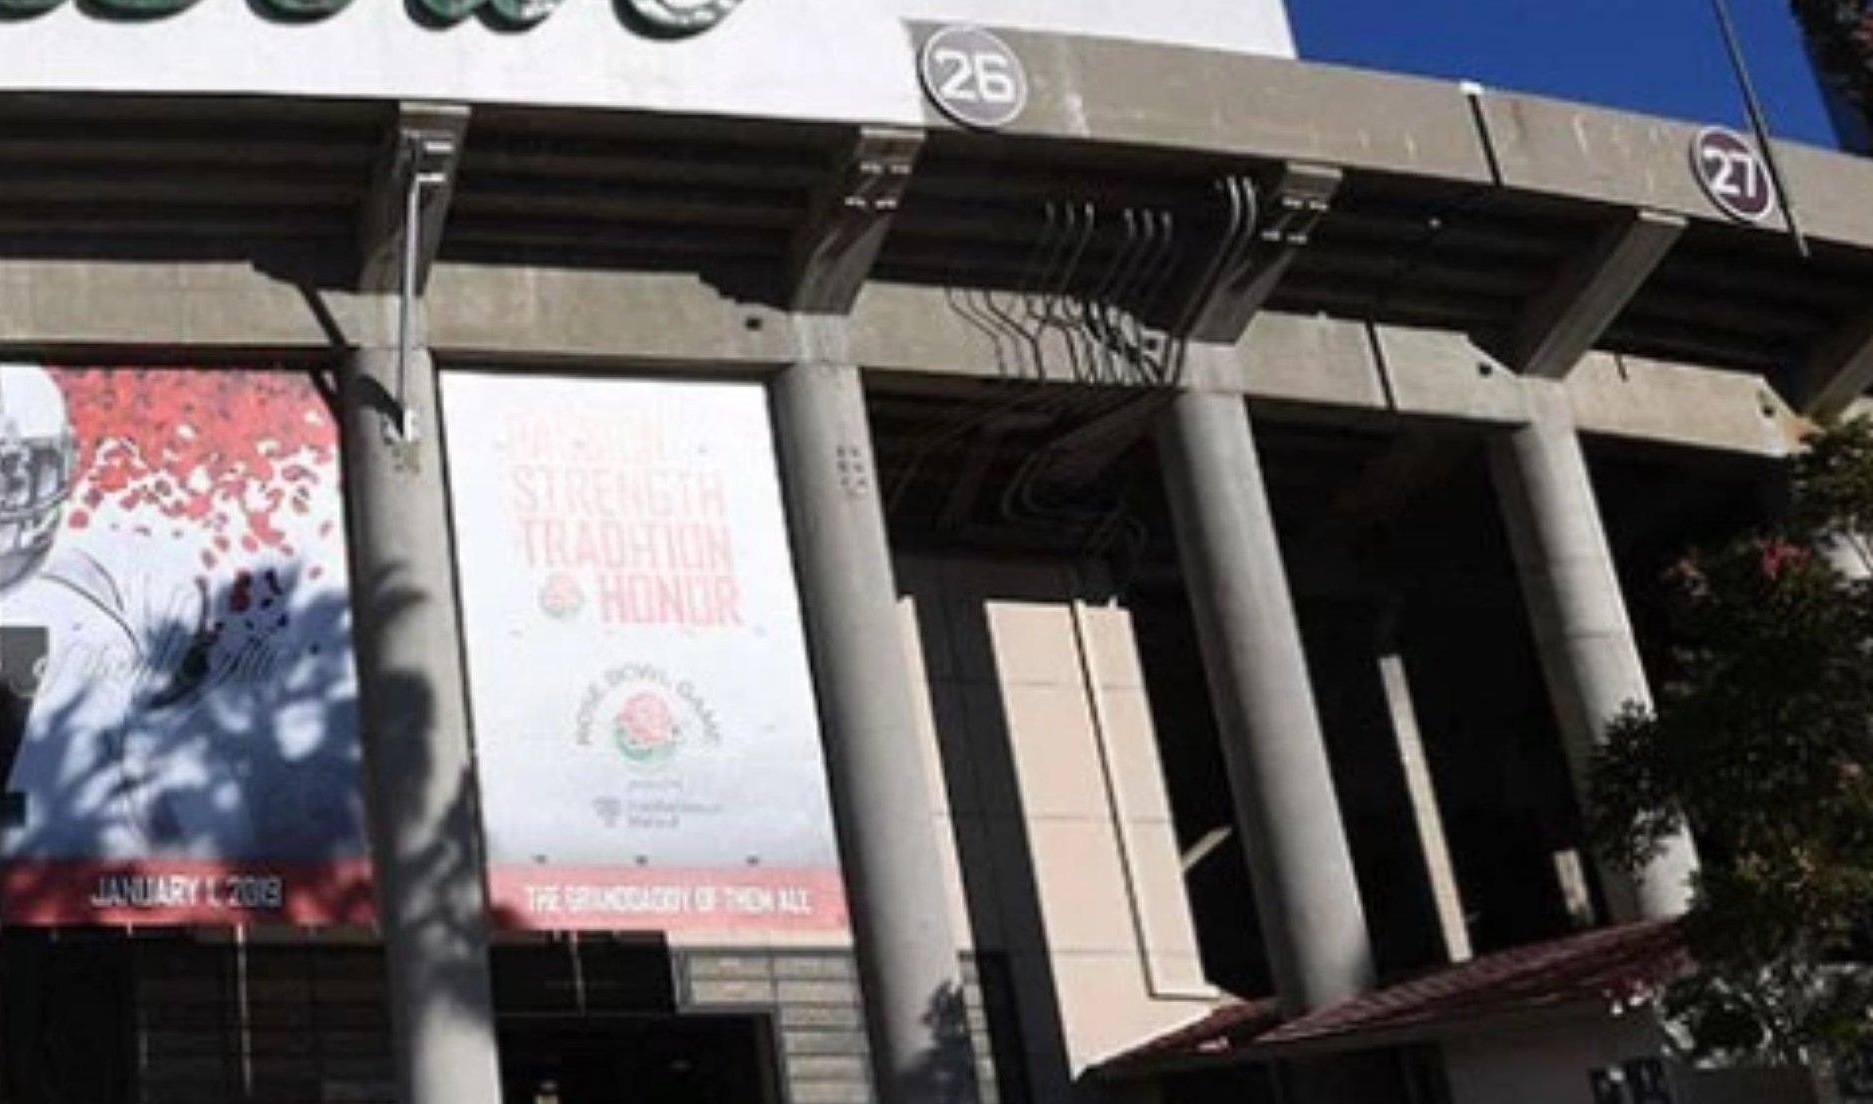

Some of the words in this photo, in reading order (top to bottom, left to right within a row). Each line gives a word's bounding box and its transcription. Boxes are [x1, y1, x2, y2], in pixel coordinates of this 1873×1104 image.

[934, 49, 1014, 103] 26
[1703, 146, 1758, 198] 27
[510, 464, 728, 518] STRENGTH
[520, 518, 736, 569] TRADITION
[598, 572, 744, 626] HONOR
[91, 874, 200, 907] JANUARY
[525, 885, 559, 913] THE
